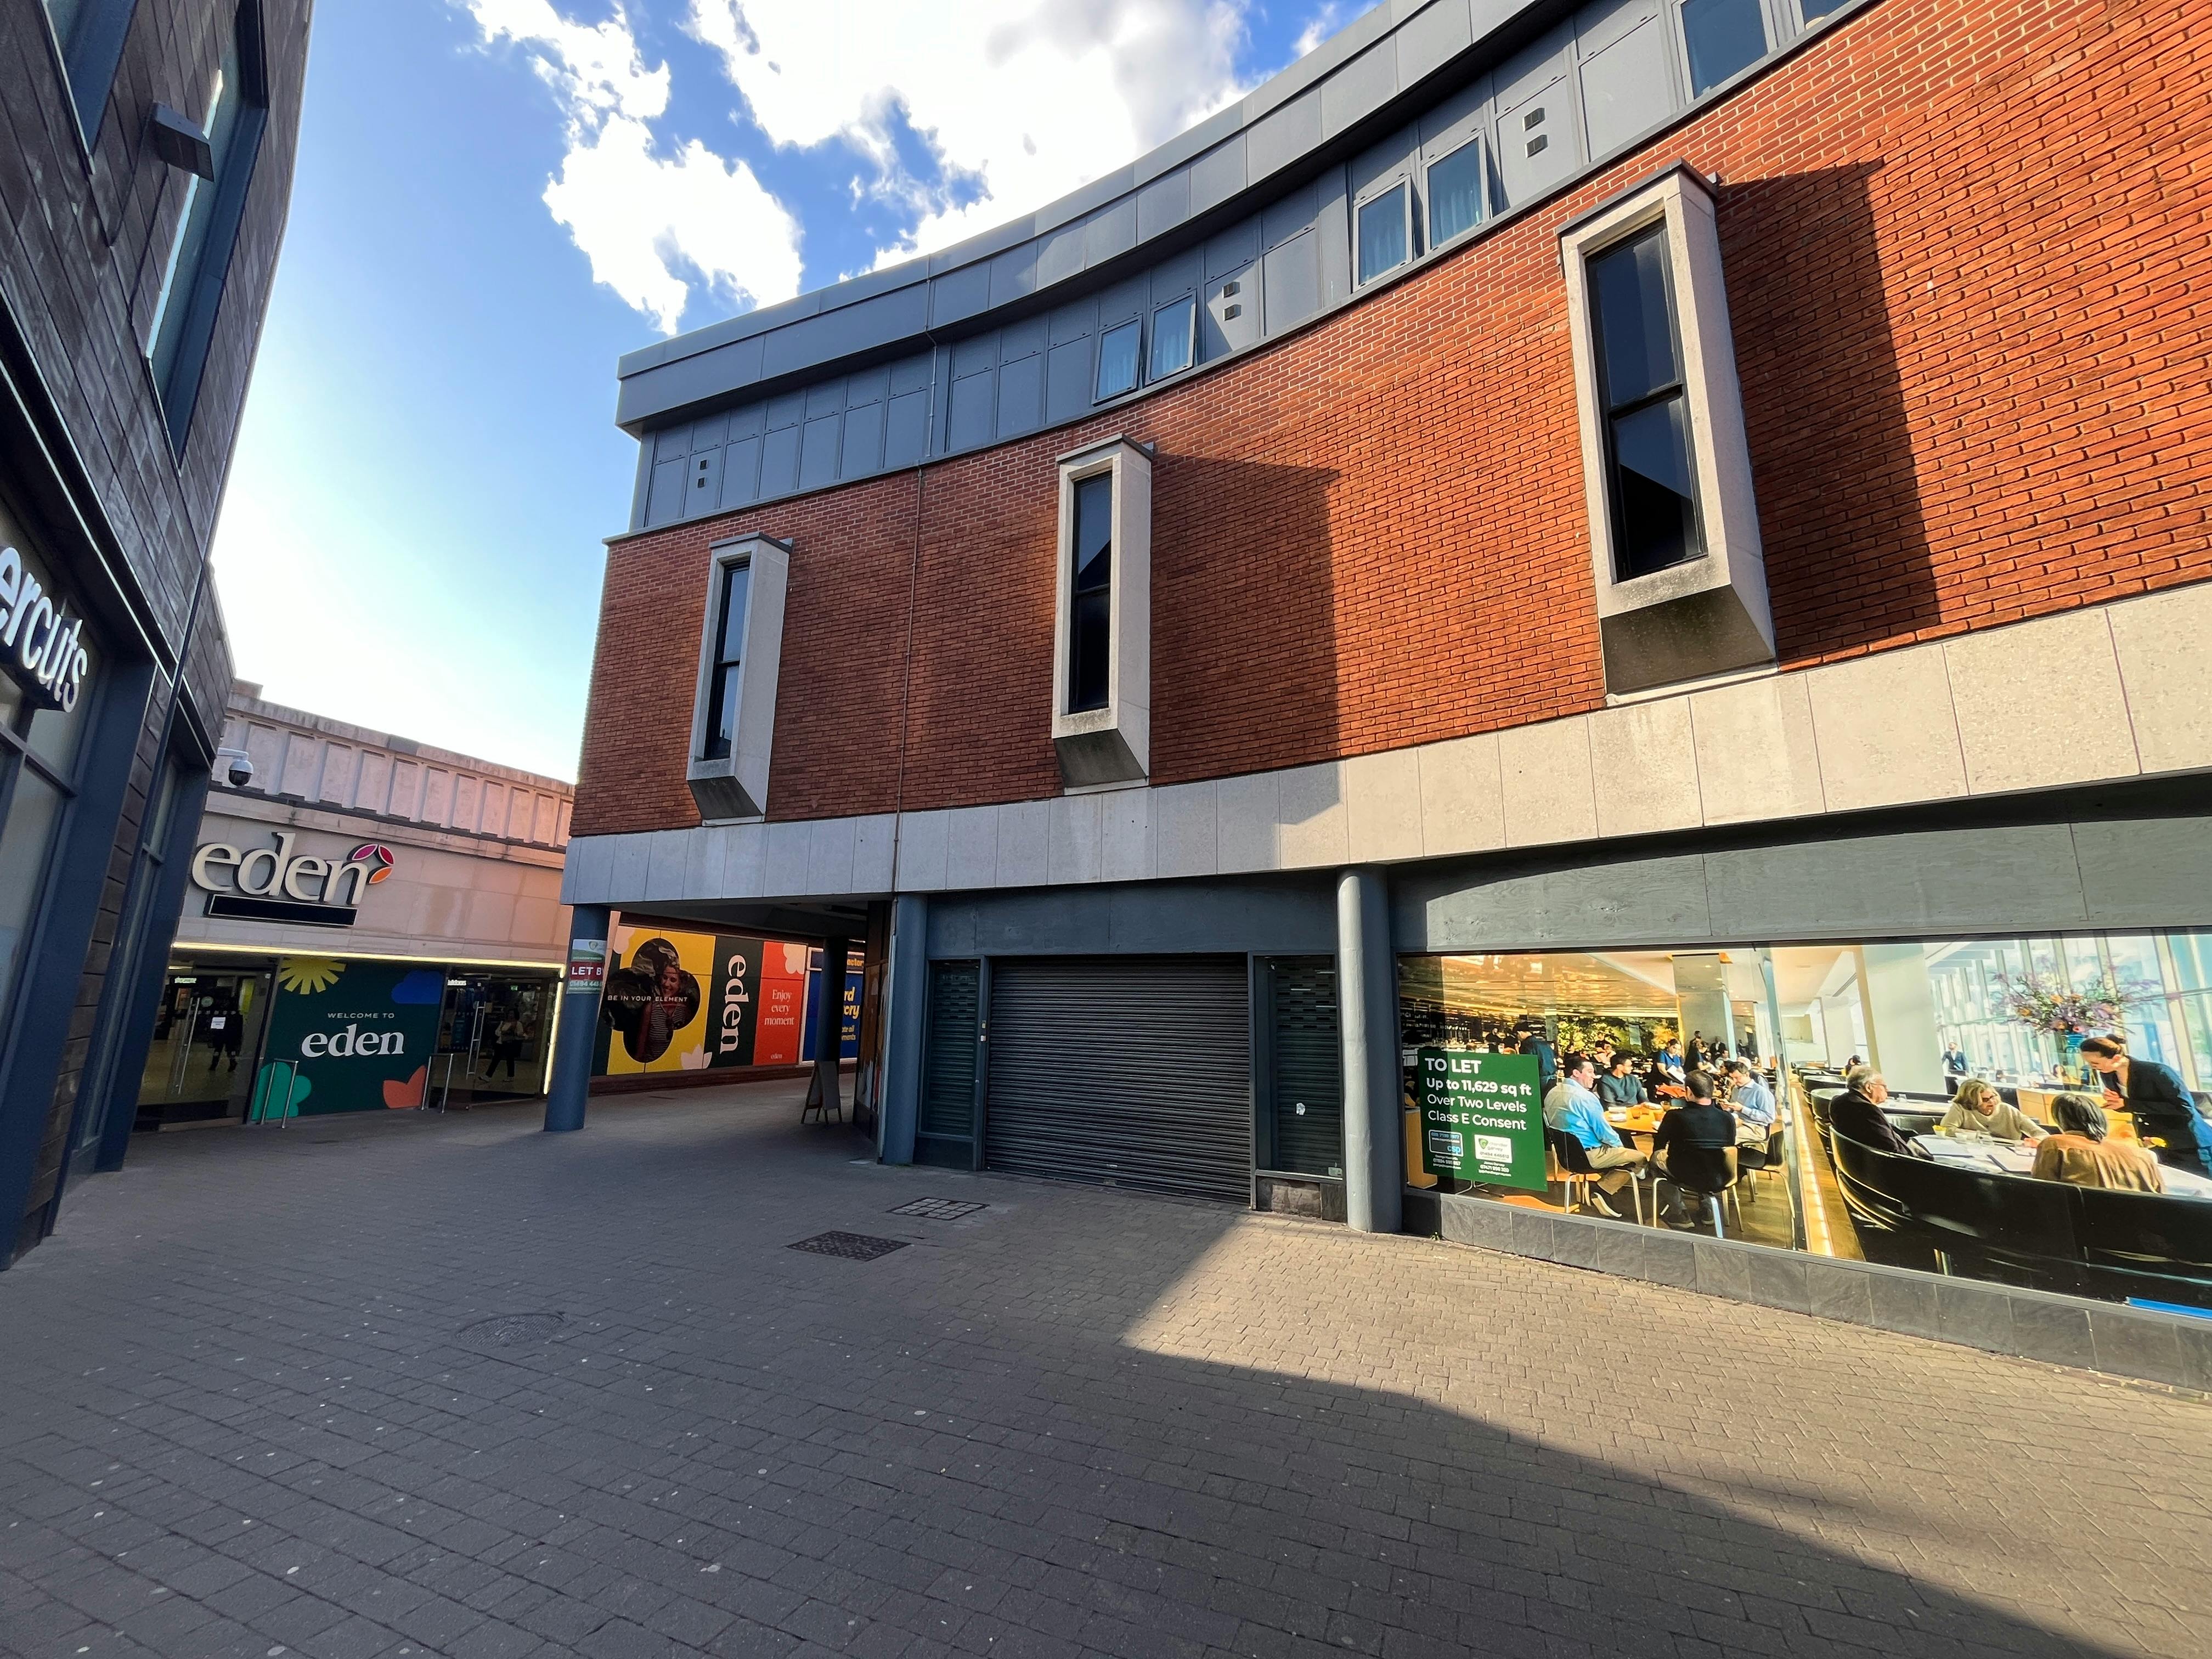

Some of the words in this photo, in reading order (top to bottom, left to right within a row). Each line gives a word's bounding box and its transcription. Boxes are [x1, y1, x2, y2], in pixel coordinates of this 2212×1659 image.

[190, 832, 368, 905] eden
[571, 966, 594, 975] LET
[719, 954, 750, 1054] eden
[771, 989, 792, 1002] Enjoy
[771, 1005, 790, 1014] every
[764, 1017, 794, 1026] moment
[301, 1024, 404, 1058] eden
[1425, 1058, 1447, 1071] TO
[1452, 1059, 1481, 1074] LET
[1426, 1077, 1443, 1090] Up
[1446, 1079, 1459, 1090] to
[1462, 1080, 1498, 1093] 11,629
[1500, 1086, 1517, 1097] sq
[1519, 1083, 1532, 1096] ft
[1427, 1094, 1454, 1107] Over
[1457, 1096, 1483, 1108] Two
[1487, 1099, 1527, 1113] Levels
[1428, 1110, 1459, 1124] Class
[1462, 1114, 1470, 1124] E
[1472, 1114, 1527, 1131] Consent
[1447, 1146, 1461, 1155] csp
